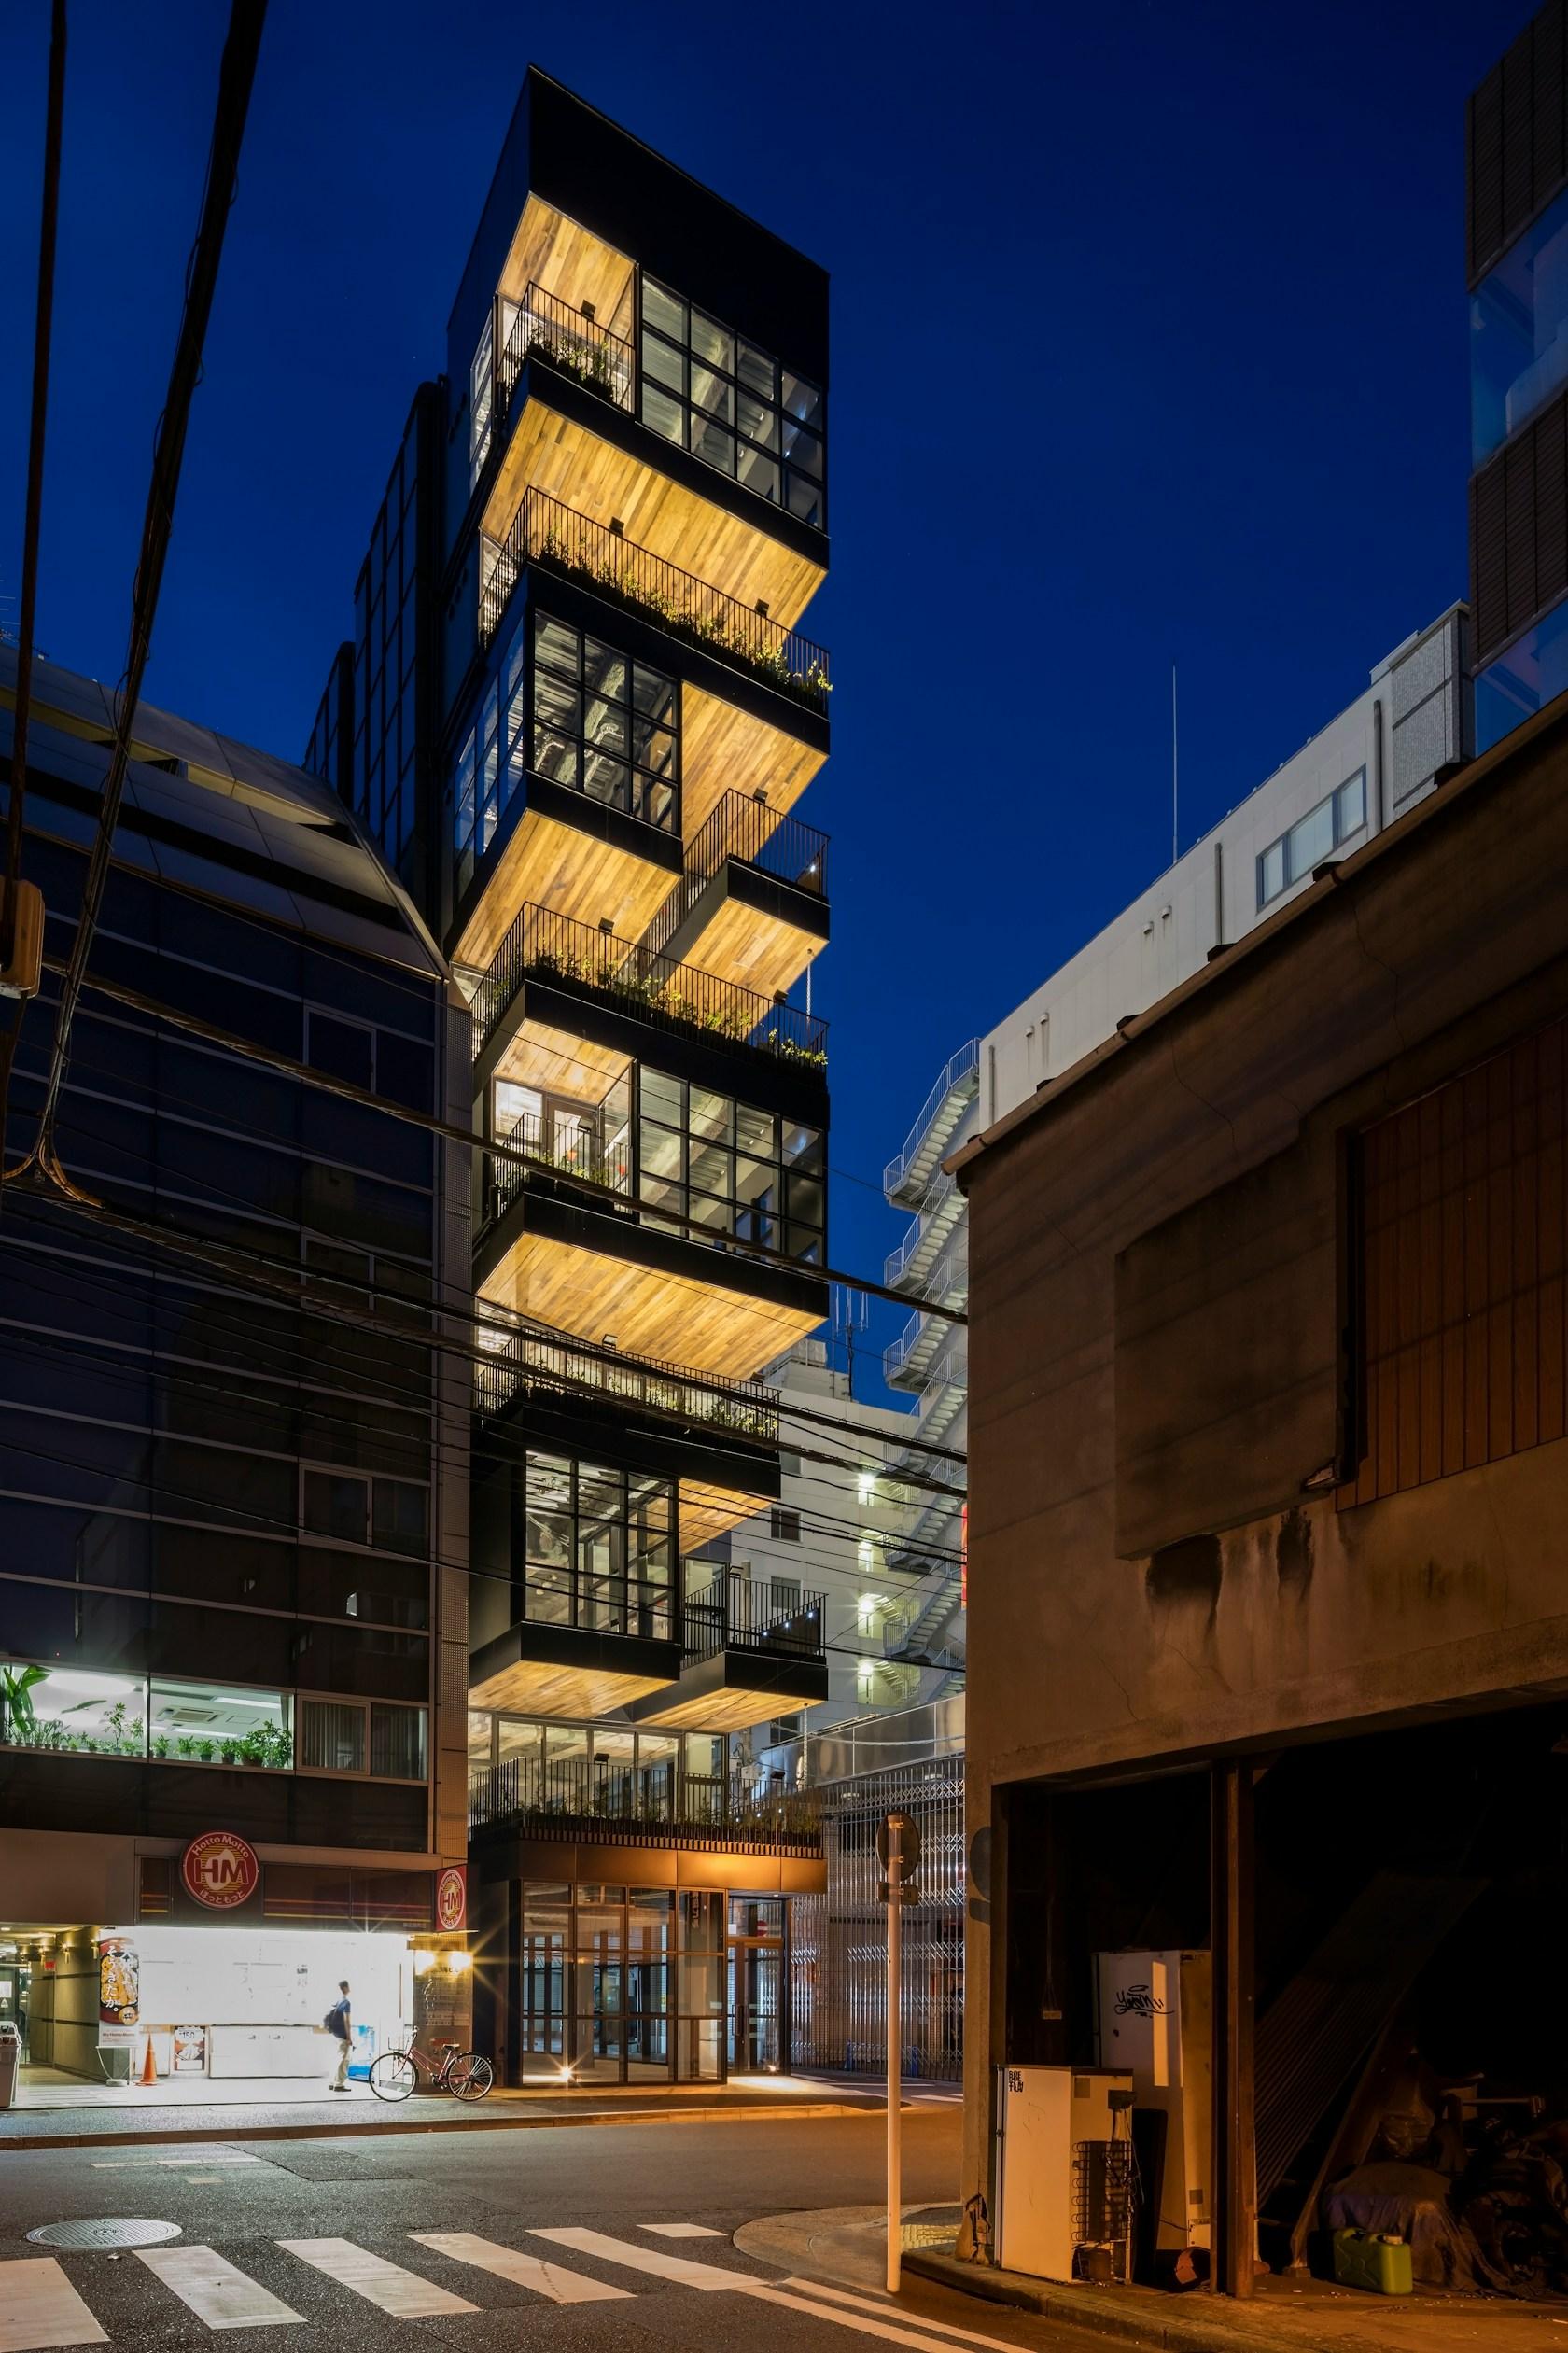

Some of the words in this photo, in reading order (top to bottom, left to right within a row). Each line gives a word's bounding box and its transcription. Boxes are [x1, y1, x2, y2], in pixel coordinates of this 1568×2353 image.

[192, 1837, 220, 1856] Hotto
[221, 1835, 249, 1858] Motto
[193, 1857, 249, 1885] HM
[199, 1888, 244, 1904] ほっともっと
[441, 1890, 461, 1912] HM
